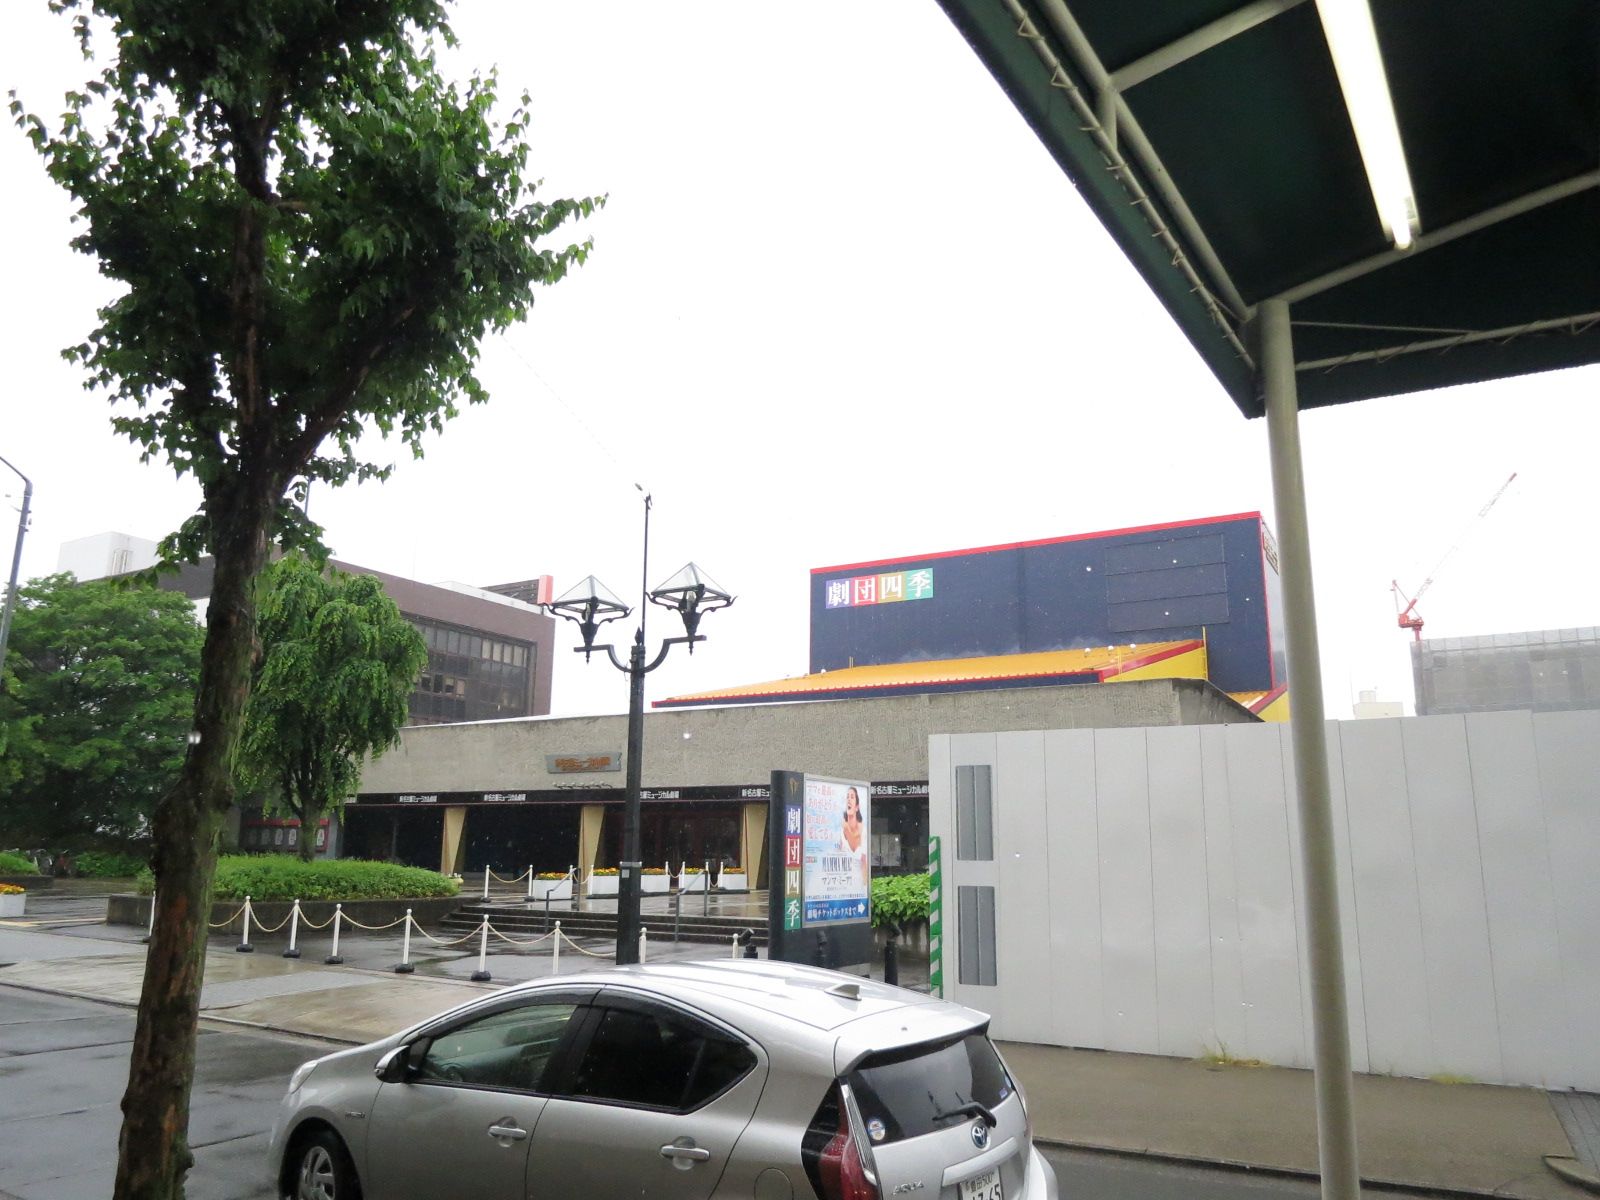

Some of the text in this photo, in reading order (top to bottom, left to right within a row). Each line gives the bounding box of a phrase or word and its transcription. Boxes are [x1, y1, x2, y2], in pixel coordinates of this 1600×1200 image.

[828, 570, 931, 607] 劇団四季
[870, 785, 929, 795] 新名古屋ミュージカル劇
[786, 807, 800, 928] 劇団四季
[822, 856, 840, 872] MAMMA
[892, 1180, 924, 1196] AQUA
